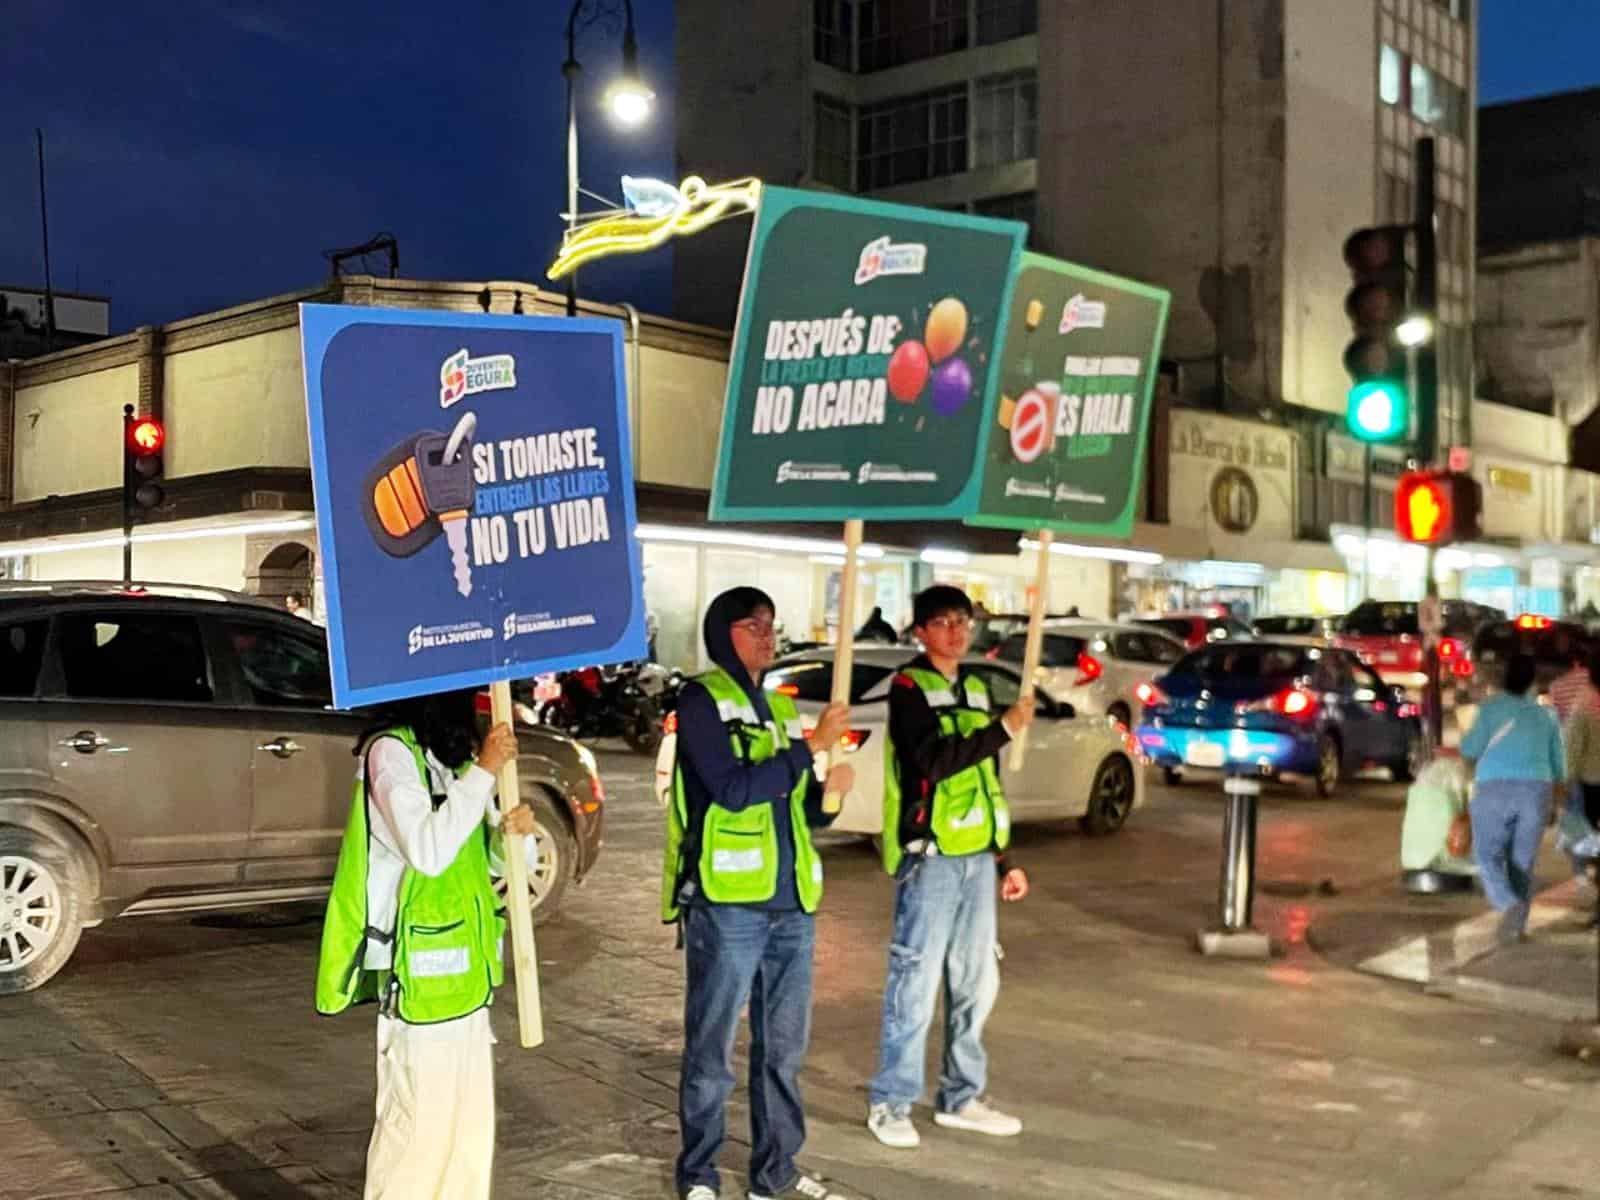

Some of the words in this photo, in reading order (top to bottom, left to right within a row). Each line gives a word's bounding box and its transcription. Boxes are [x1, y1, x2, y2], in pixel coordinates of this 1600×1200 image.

[764, 308, 866, 360] DESPUÉS
[866, 315, 900, 354] DE
[752, 385, 794, 434] NO
[797, 378, 888, 431] ACABA
[1054, 394, 1080, 436] ES
[1080, 393, 1134, 435] MALA
[472, 442, 496, 484] SI
[499, 427, 605, 481] TOMASTE,
[475, 481, 534, 516] ENTREGA
[536, 475, 563, 505] LAS
[563, 470, 610, 499] LLAVES
[471, 515, 509, 566] NO
[513, 507, 546, 558] TU
[550, 496, 610, 549] VIDA
